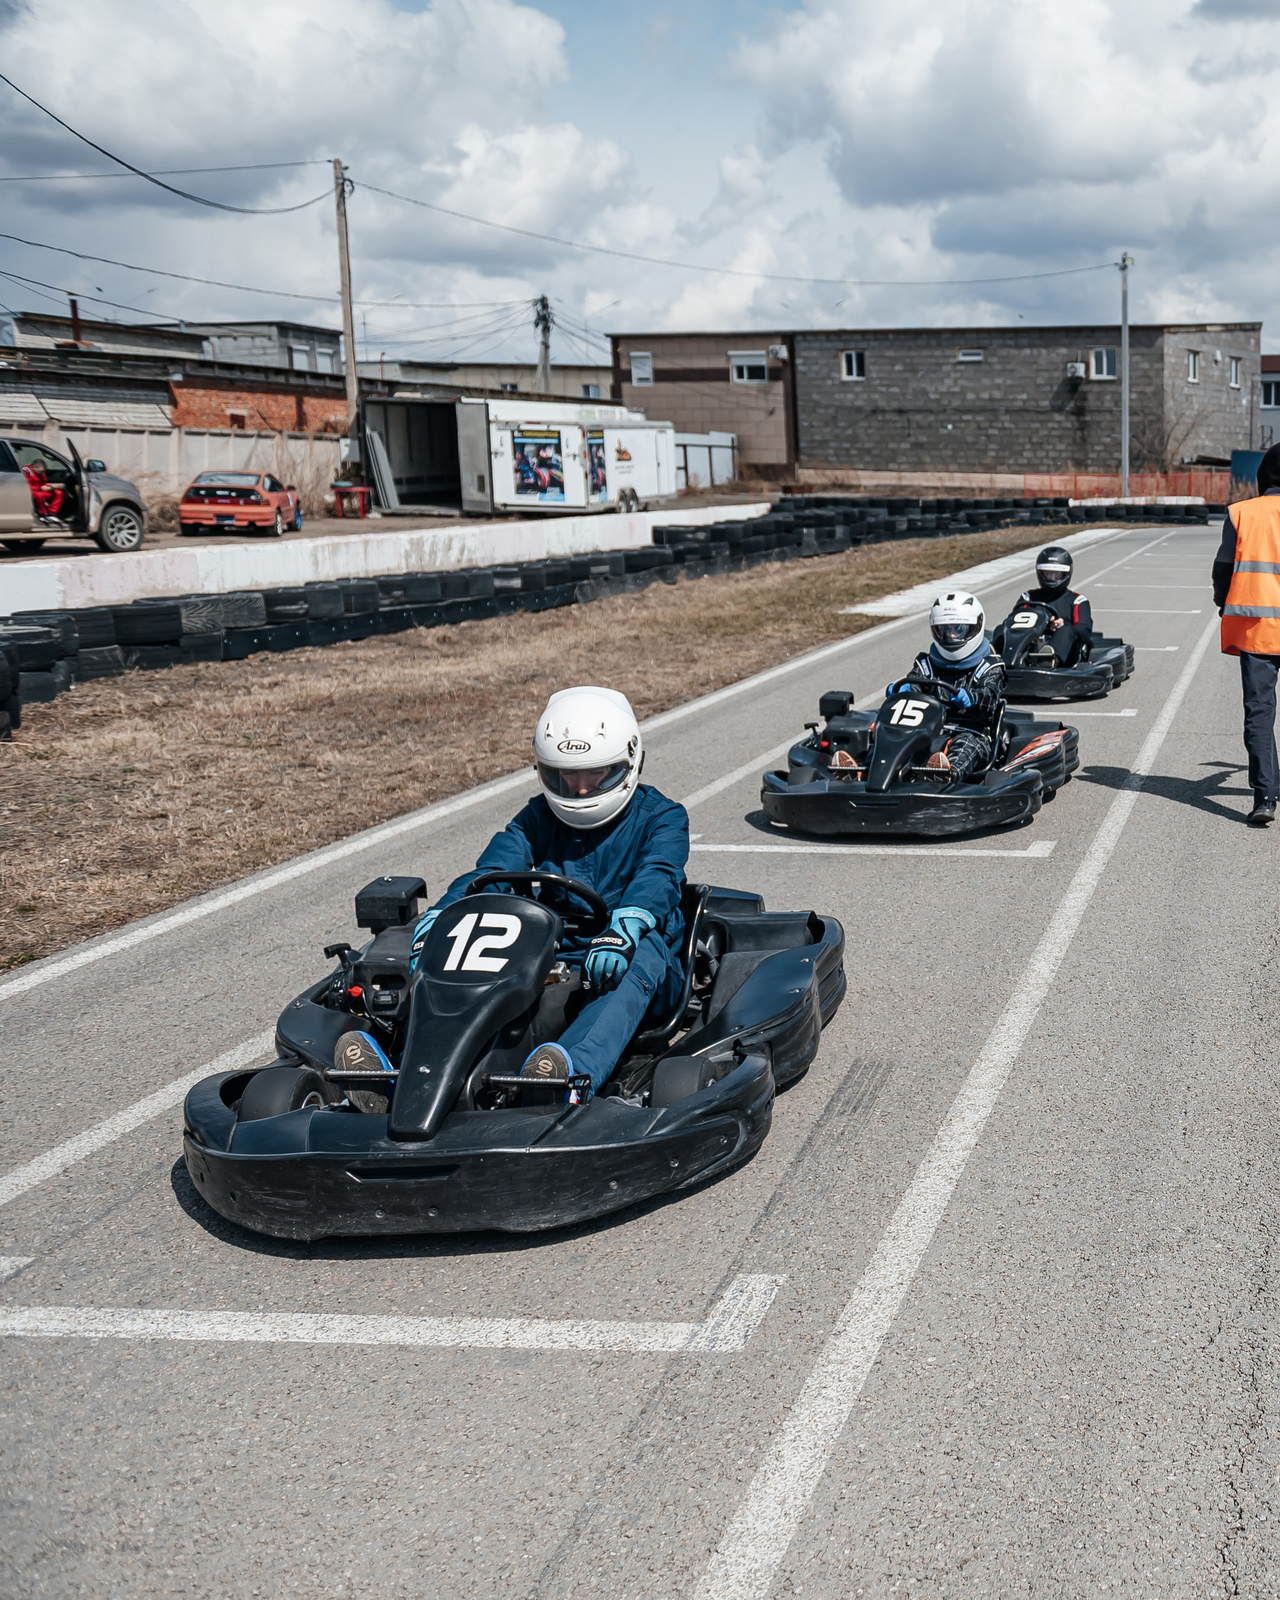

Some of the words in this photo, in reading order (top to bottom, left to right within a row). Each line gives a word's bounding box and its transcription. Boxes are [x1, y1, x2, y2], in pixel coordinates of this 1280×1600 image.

[1011, 611, 1038, 629] 9
[889, 699, 930, 727] 15
[562, 741, 587, 751] Arai
[443, 913, 522, 972] 12
